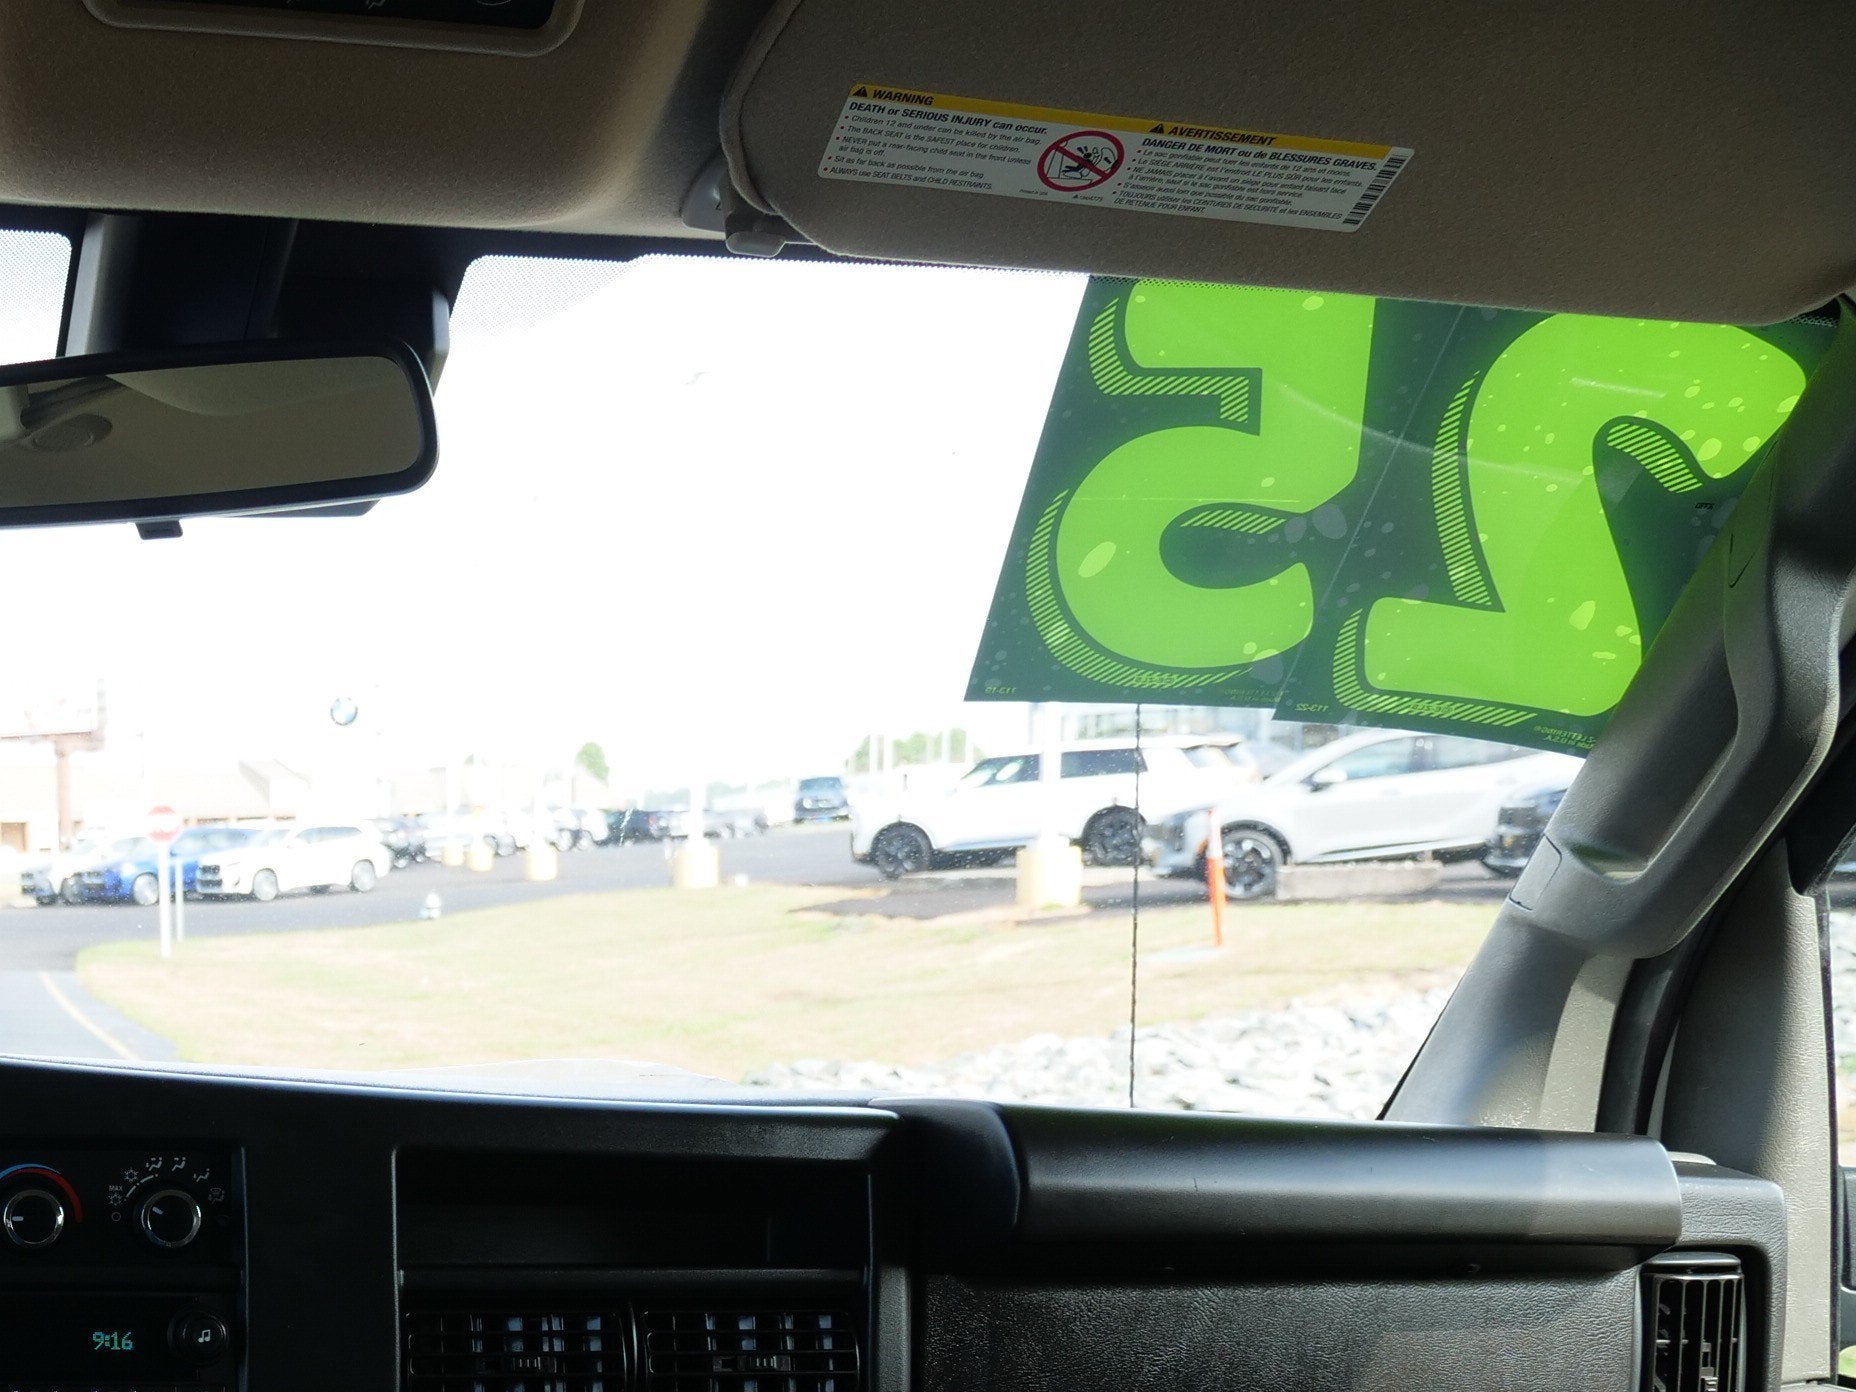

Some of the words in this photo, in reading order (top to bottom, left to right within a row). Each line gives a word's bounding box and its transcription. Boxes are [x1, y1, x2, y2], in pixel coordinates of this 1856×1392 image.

[870, 89, 935, 105] WARNING
[848, 101, 886, 114] DEATH
[886, 108, 900, 116] or
[900, 108, 950, 122] SERIOUS
[949, 114, 992, 127] INJURY
[991, 121, 1014, 130] can
[1014, 124, 1049, 134] occur.
[1167, 125, 1276, 146] AVERTISSEMENT
[1141, 137, 1187, 150] DANGER
[1186, 142, 1204, 152] DE
[1203, 144, 1238, 156] MORT
[1236, 149, 1253, 157] ou
[1252, 150, 1269, 159] de
[1267, 150, 1333, 166] BLESSURES
[1331, 158, 1380, 171] GRAVES.
[109, 1185, 122, 1193] MAX
[93, 1332, 133, 1350] 9:16
